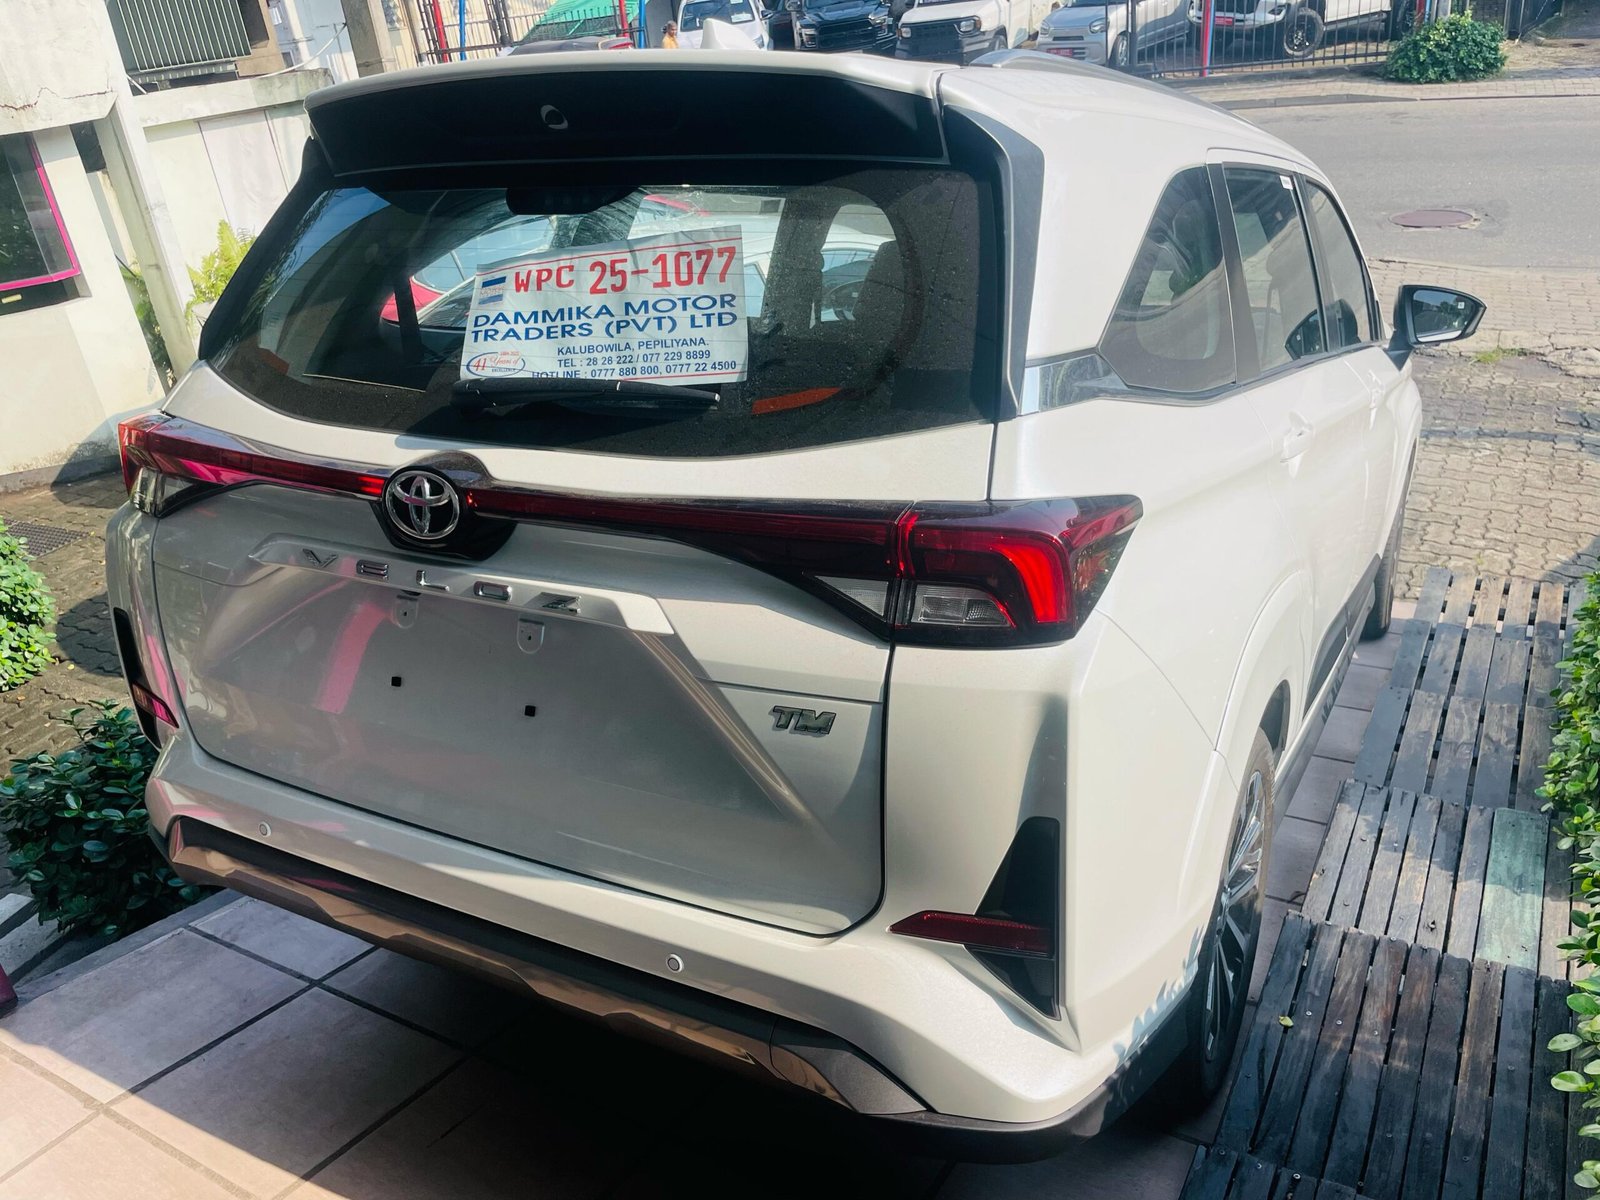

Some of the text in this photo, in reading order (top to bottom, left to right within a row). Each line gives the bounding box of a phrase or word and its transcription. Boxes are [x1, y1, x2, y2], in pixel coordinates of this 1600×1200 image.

[514, 246, 736, 295] WPC 25-1077
[473, 293, 737, 328] DAMMIKA MOTOR
[471, 311, 738, 343] TRADERS (PVT) LTD
[557, 337, 710, 356] KALUBOWILA, PEPILIYANA.
[557, 358, 577, 368] TEL
[586, 357, 599, 366] 28
[601, 356, 614, 365] 28
[616, 354, 634, 364] 222
[642, 352, 660, 363] 077
[664, 350, 682, 361] 229
[685, 349, 711, 360] 8899
[473, 358, 487, 371] 41
[532, 370, 580, 378] HOTLINE
[590, 368, 615, 378] 0777
[618, 366, 637, 376] 880
[665, 363, 690, 374] 0777
[694, 362, 707, 372] 22
[710, 360, 737, 371] 4500
[302, 547, 583, 615] VELOZ
[772, 704, 838, 735] TM
